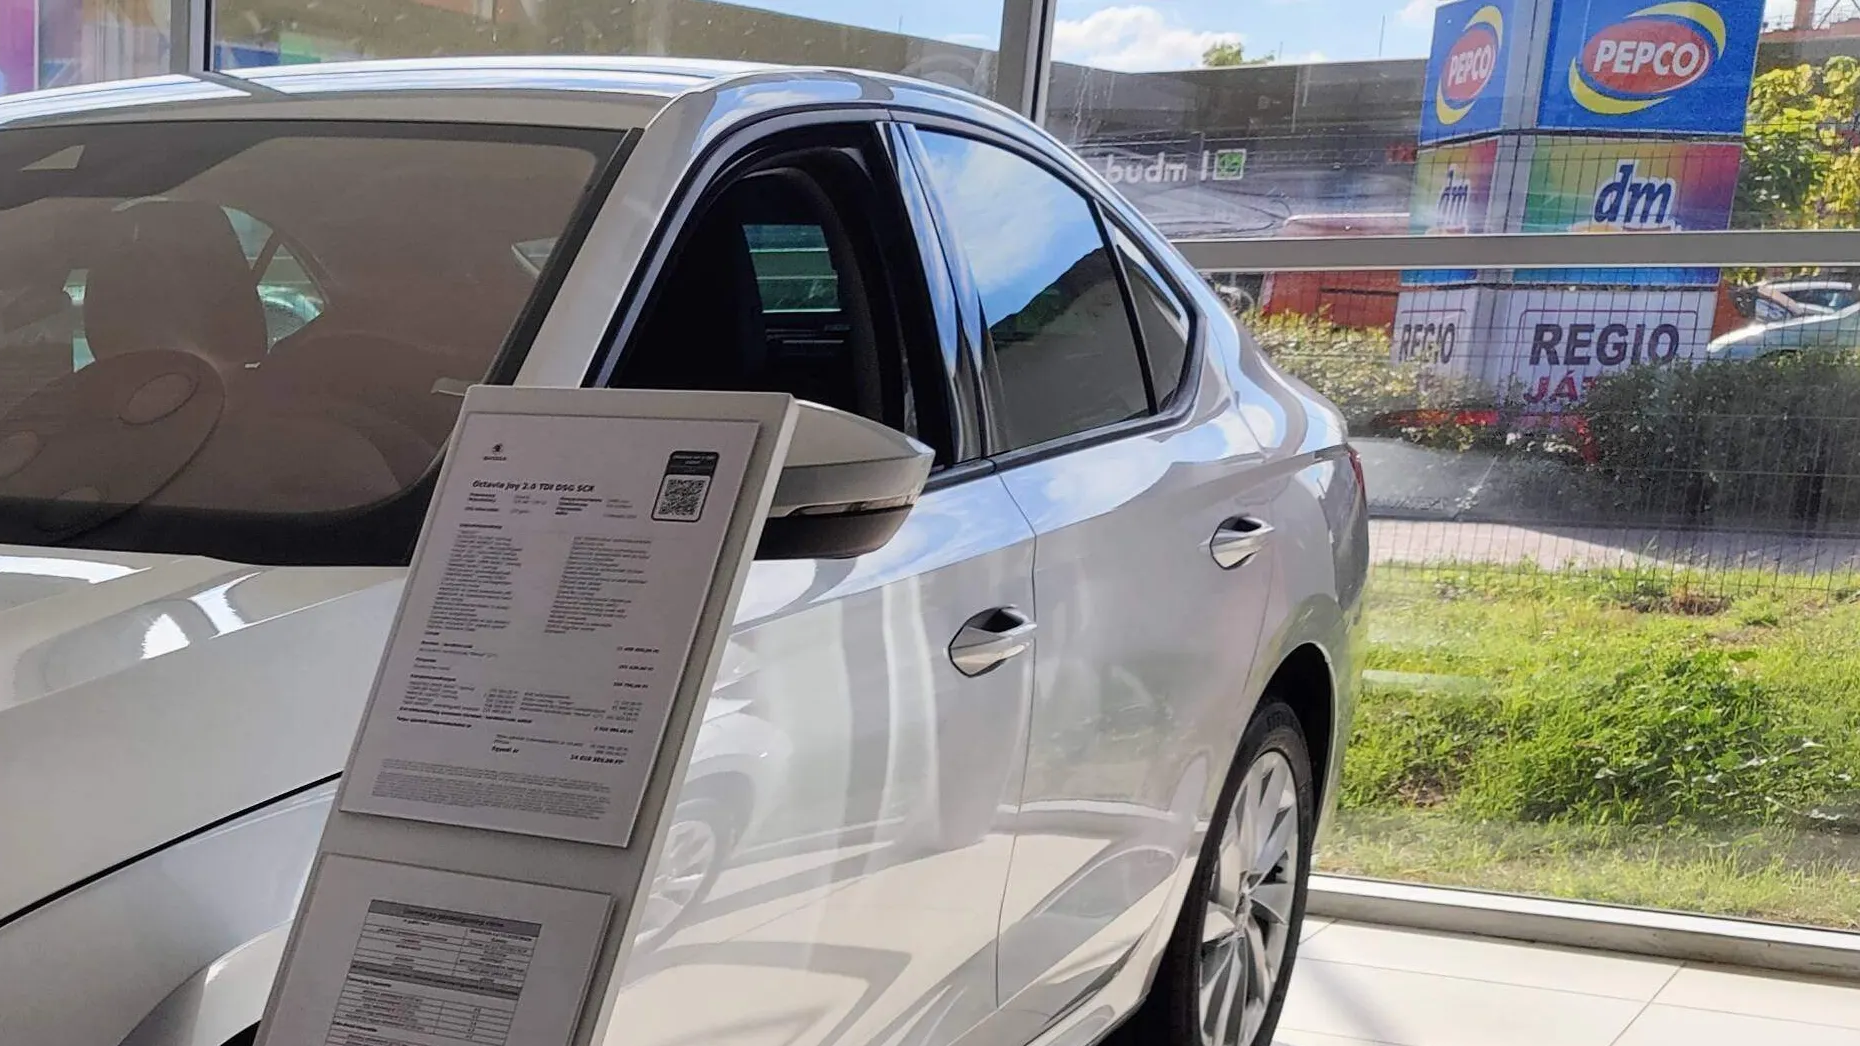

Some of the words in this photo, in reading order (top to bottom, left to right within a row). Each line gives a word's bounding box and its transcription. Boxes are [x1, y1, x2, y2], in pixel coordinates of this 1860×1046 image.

[1448, 46, 1492, 87] PEPCO
[1593, 39, 1700, 77] PEPCO
[1440, 170, 1468, 223] dm
[1593, 164, 1674, 224] dm
[1398, 322, 1455, 365] REGIO
[1527, 322, 1680, 367] REGIO
[472, 479, 504, 489] Octavia
